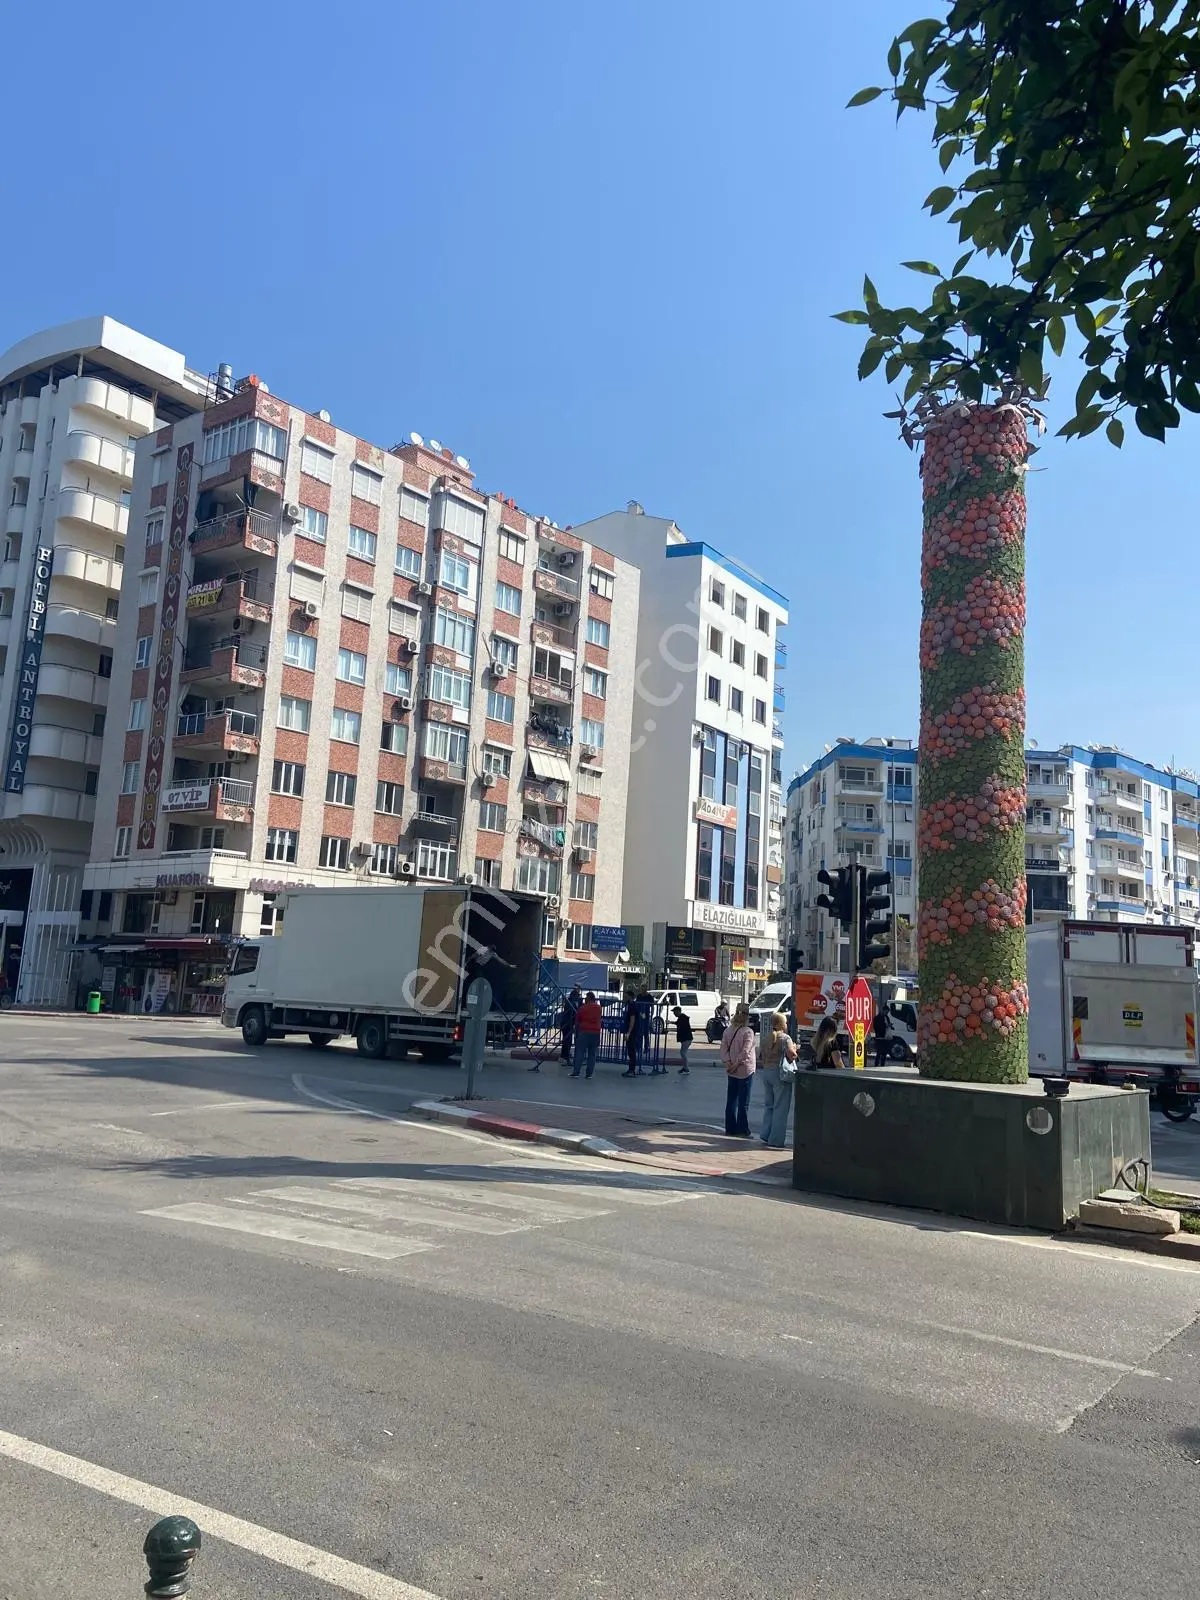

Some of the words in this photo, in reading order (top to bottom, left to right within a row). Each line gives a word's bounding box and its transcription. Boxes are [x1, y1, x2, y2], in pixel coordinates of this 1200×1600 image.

[30, 547, 52, 632] HOTEL
[10, 652, 37, 791] ANTROYAL
[703, 908, 758, 929] ELAZIĞLILAR
[847, 997, 870, 1021] DUR
